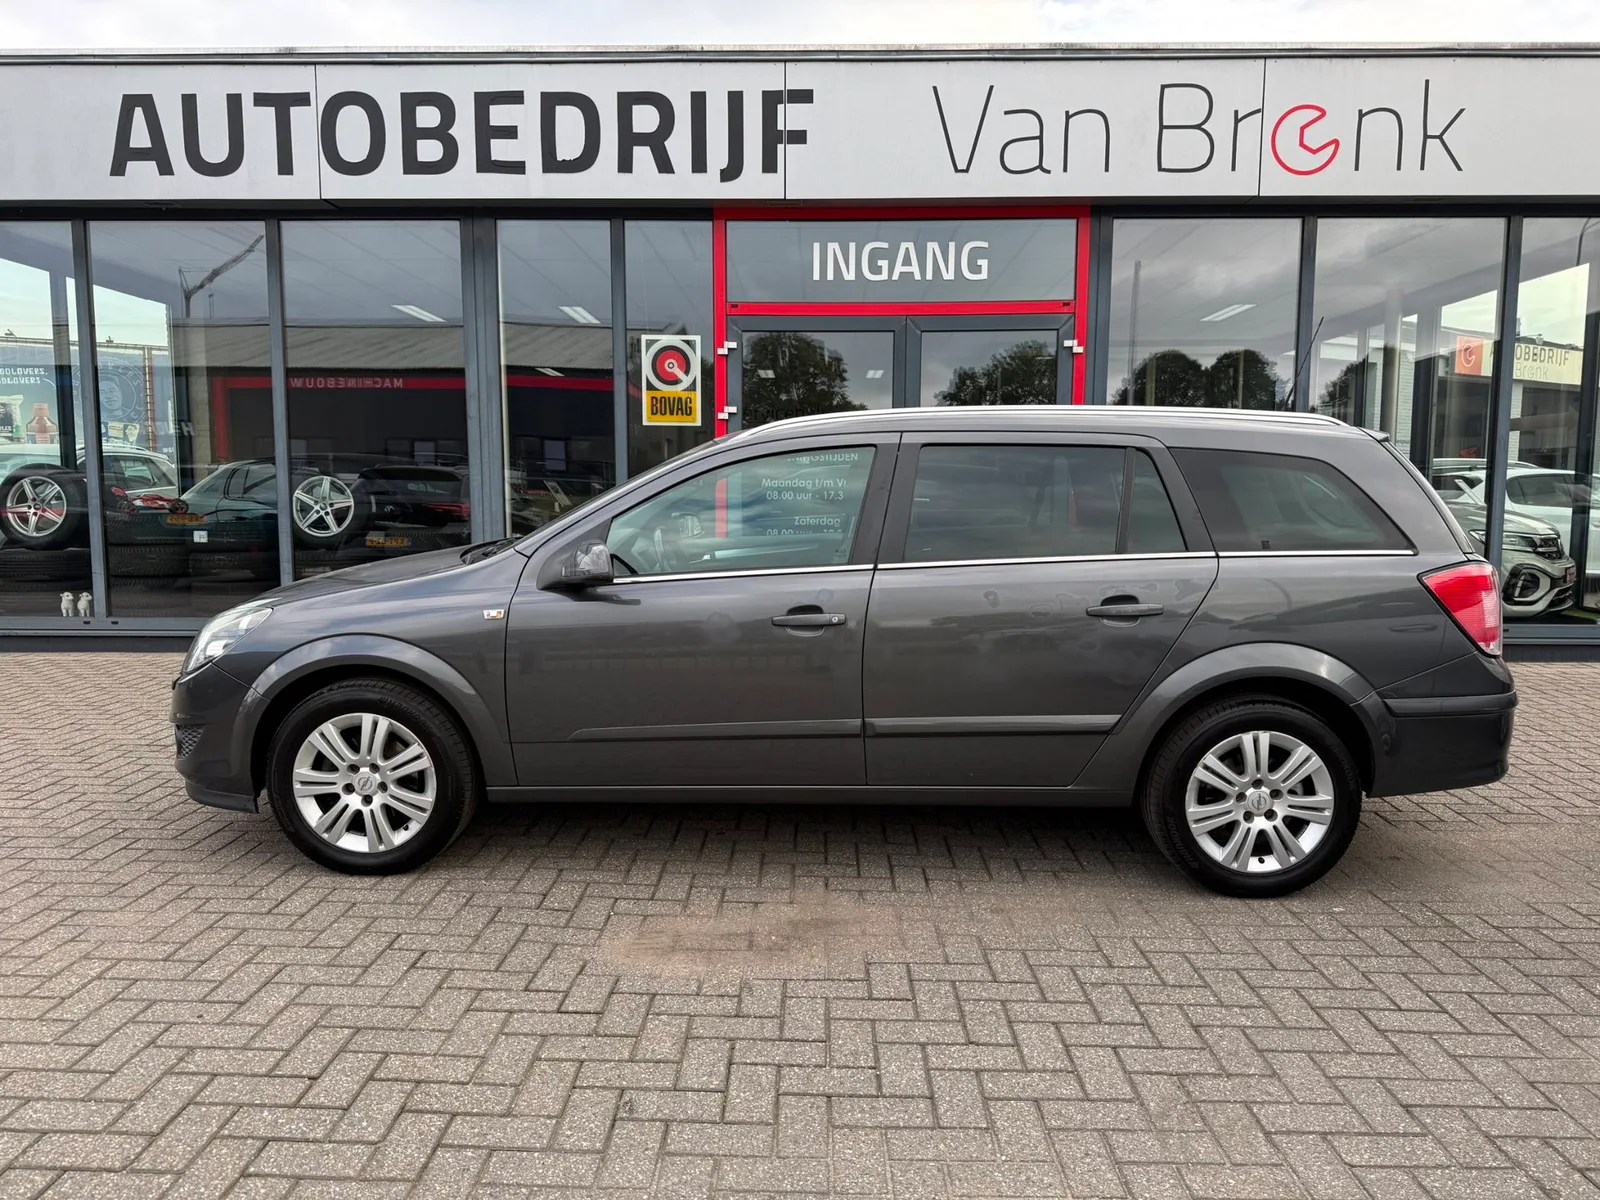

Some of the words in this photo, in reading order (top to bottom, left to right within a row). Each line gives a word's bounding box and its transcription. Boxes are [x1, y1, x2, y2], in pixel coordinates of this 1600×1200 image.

[109, 89, 814, 183] AUTOBEDRIJF
[931, 84, 1111, 175] Van
[812, 241, 989, 281] INGANG
[650, 396, 693, 416] BOVAG
[761, 478, 812, 489] Maandag
[815, 478, 833, 487] t/m
[766, 491, 794, 500] 08.00
[794, 516, 841, 528] Zaterdag
